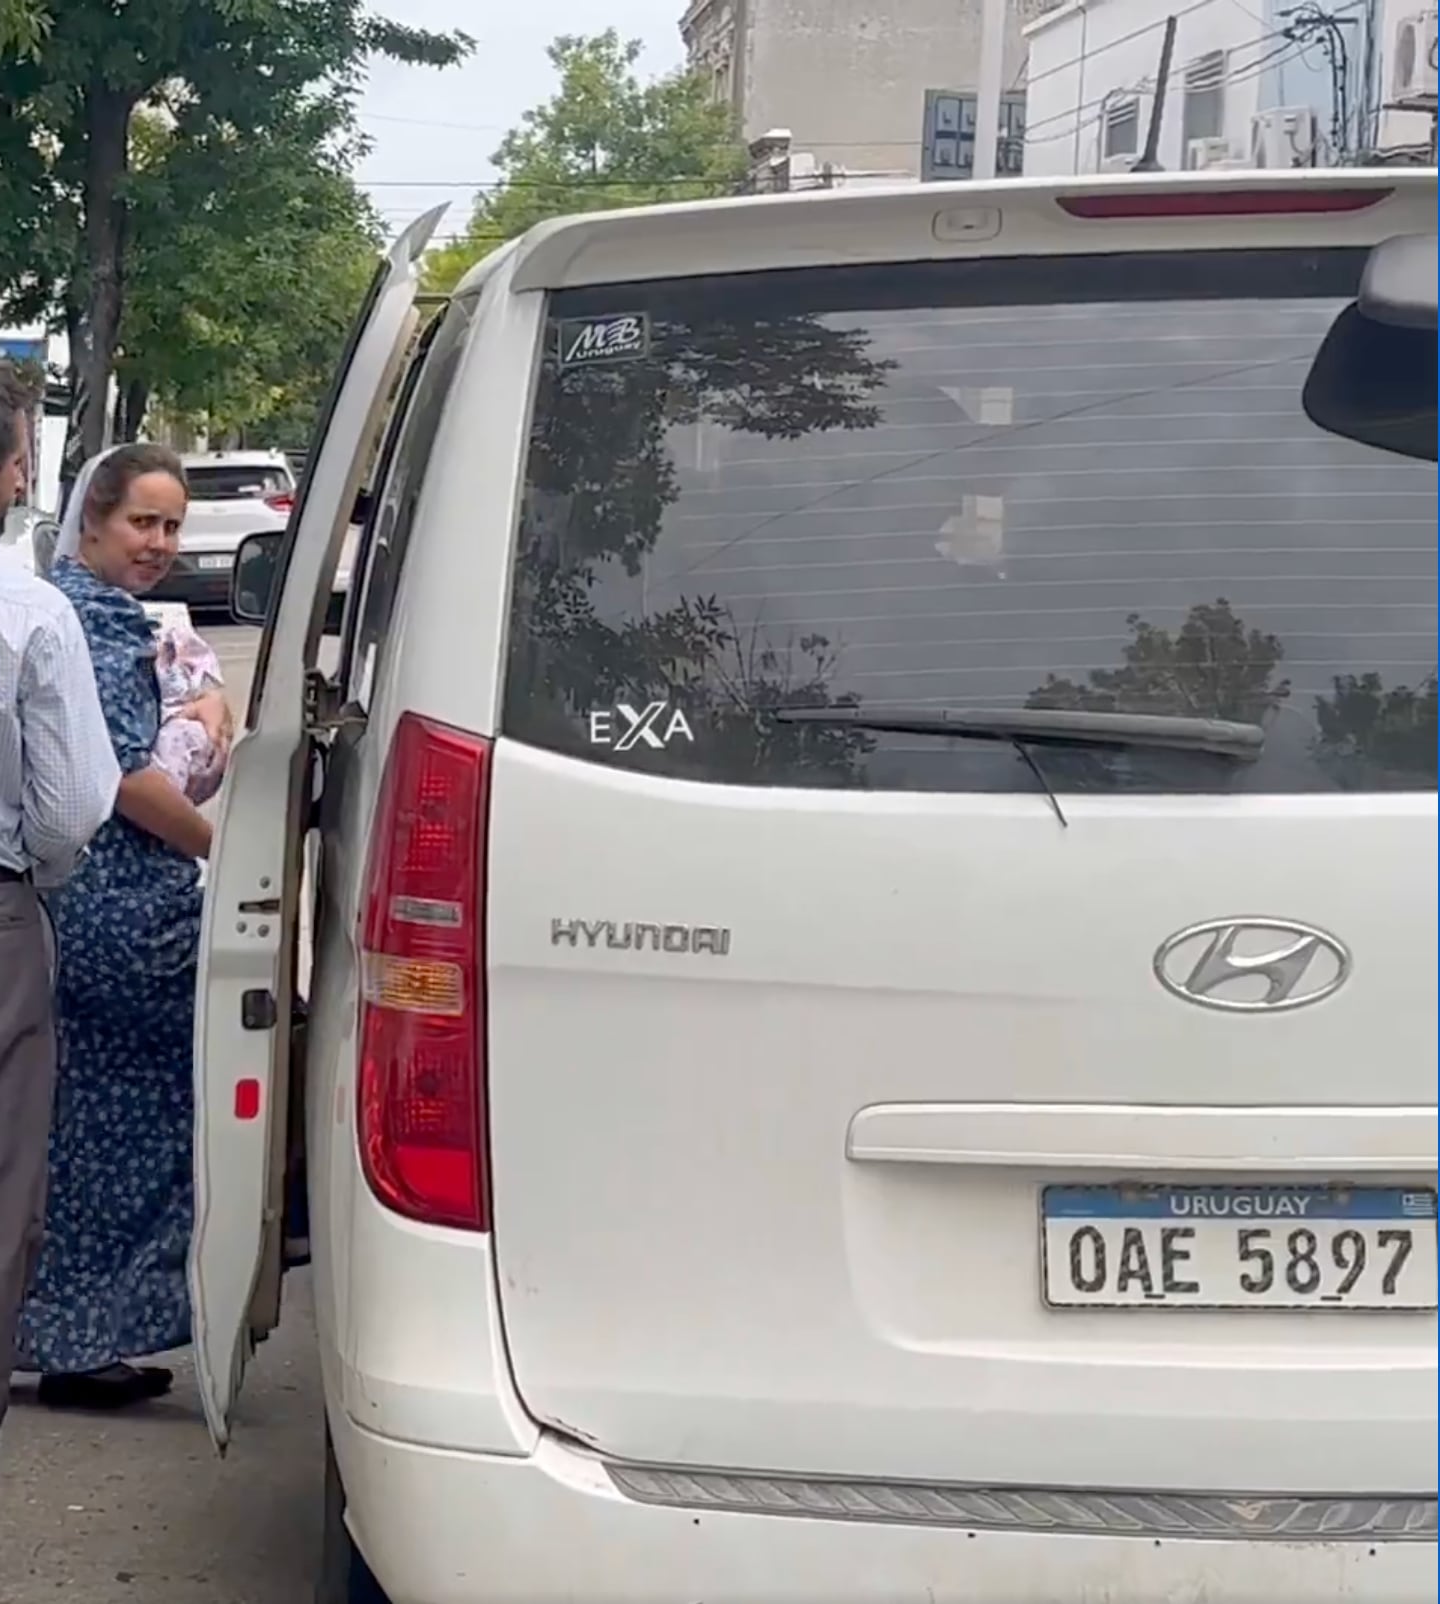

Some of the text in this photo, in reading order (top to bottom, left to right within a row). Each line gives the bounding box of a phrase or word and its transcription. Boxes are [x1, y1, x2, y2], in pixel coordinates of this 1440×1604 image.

[590, 701, 694, 751] EXA
[551, 917, 731, 955] HYUNDAI
[1169, 1195, 1311, 1217] URUGUAY
[1069, 1225, 1413, 1297] OAE 5897
